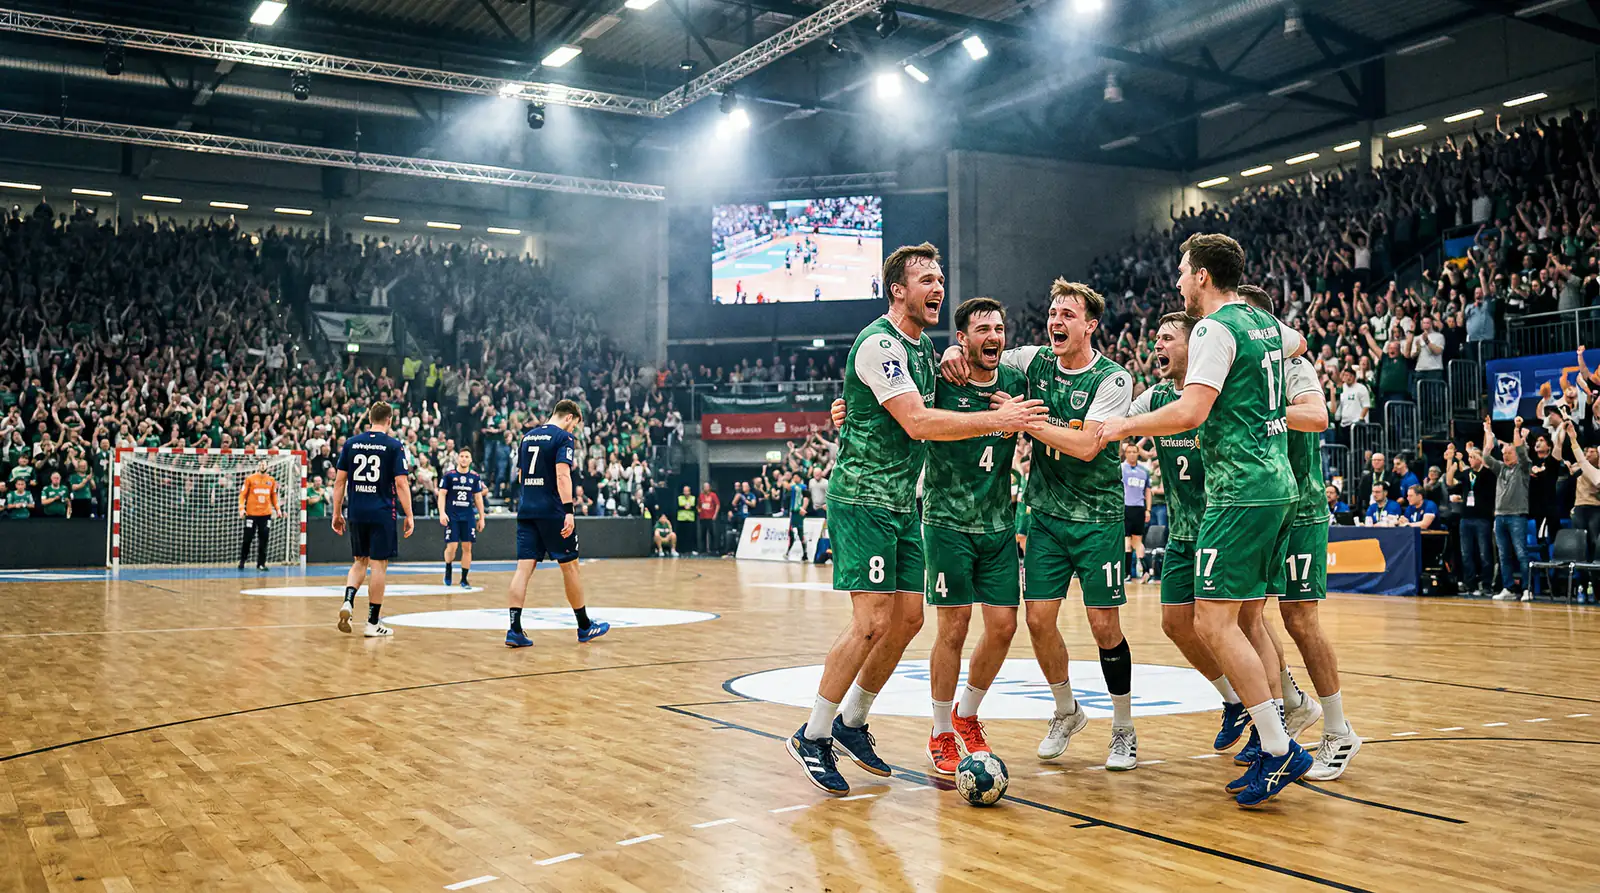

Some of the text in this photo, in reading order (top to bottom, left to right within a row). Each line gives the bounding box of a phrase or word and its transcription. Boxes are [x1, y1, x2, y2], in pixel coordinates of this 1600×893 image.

[352, 453, 381, 483] 23
[527, 445, 540, 475] 7
[979, 445, 994, 472] 4
[1176, 455, 1191, 480] 2
[868, 555, 885, 584] 8
[1101, 560, 1121, 588] 11
[1195, 548, 1218, 577] 17
[1285, 553, 1312, 581] 17
[935, 572, 949, 598] 4
